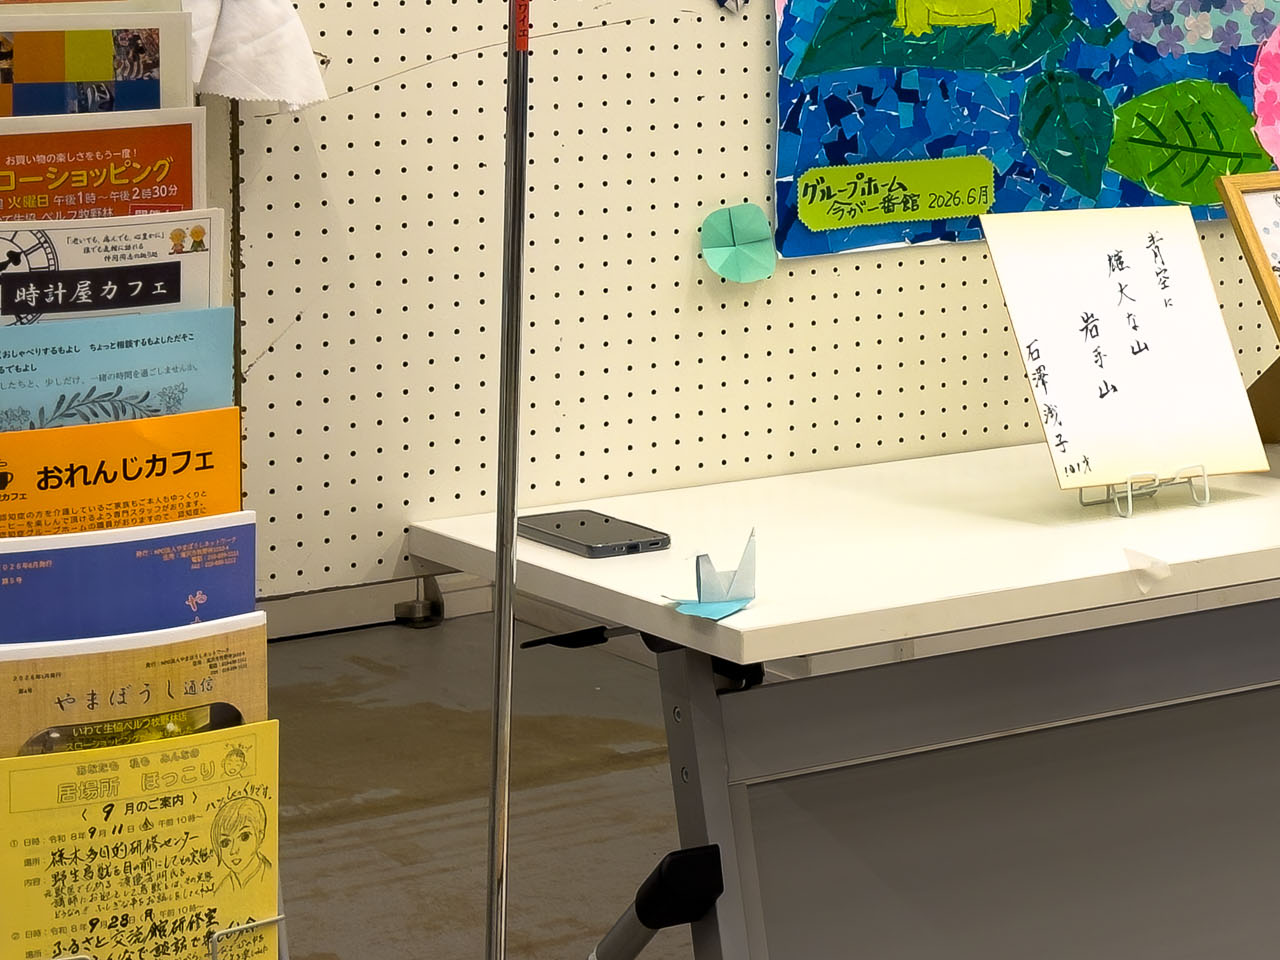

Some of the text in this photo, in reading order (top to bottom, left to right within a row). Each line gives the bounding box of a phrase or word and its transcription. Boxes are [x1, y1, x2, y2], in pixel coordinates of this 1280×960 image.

[8, 194, 50, 209] 火曜日
[801, 172, 909, 206] グループホーム
[1144, 230, 1175, 309] 青空に
[14, 279, 168, 307] 時計屋カフェ
[1078, 311, 1119, 400] 岩手山
[36, 449, 215, 492] おれんじカフェ
[54, 676, 216, 712] やまぼうし通信
[56, 759, 217, 805] 居場所 ほっこり
